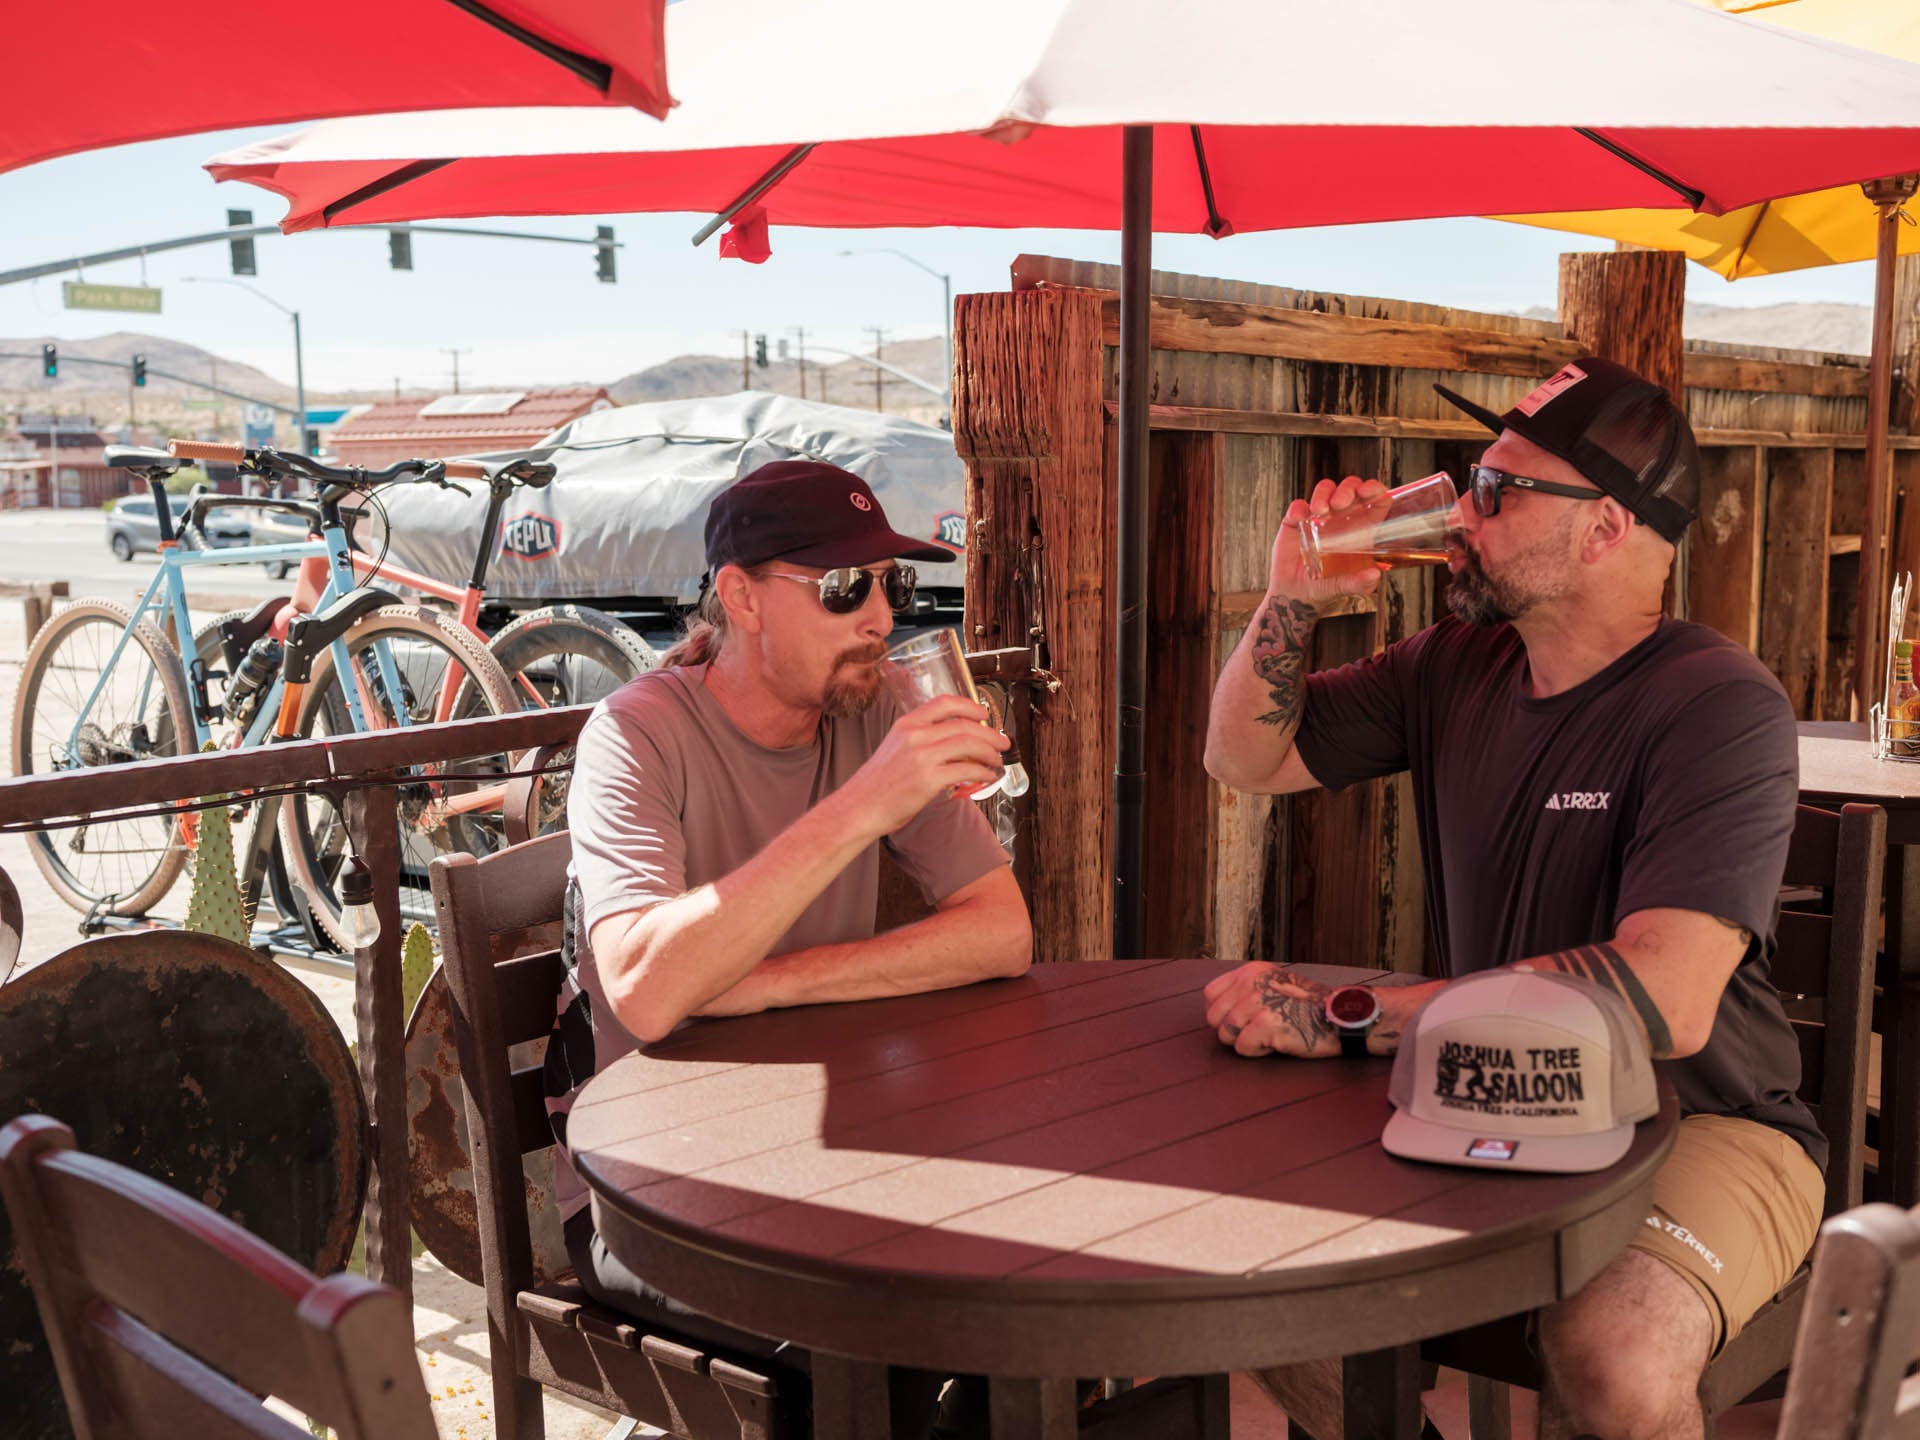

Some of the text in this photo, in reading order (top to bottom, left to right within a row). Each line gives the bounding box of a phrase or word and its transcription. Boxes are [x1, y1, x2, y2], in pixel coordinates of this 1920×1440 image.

[1440, 1041, 1581, 1070] JOSHUA TREE
[1490, 1072, 1584, 1103] SALOON
[1665, 1221, 1724, 1274] TERREX
